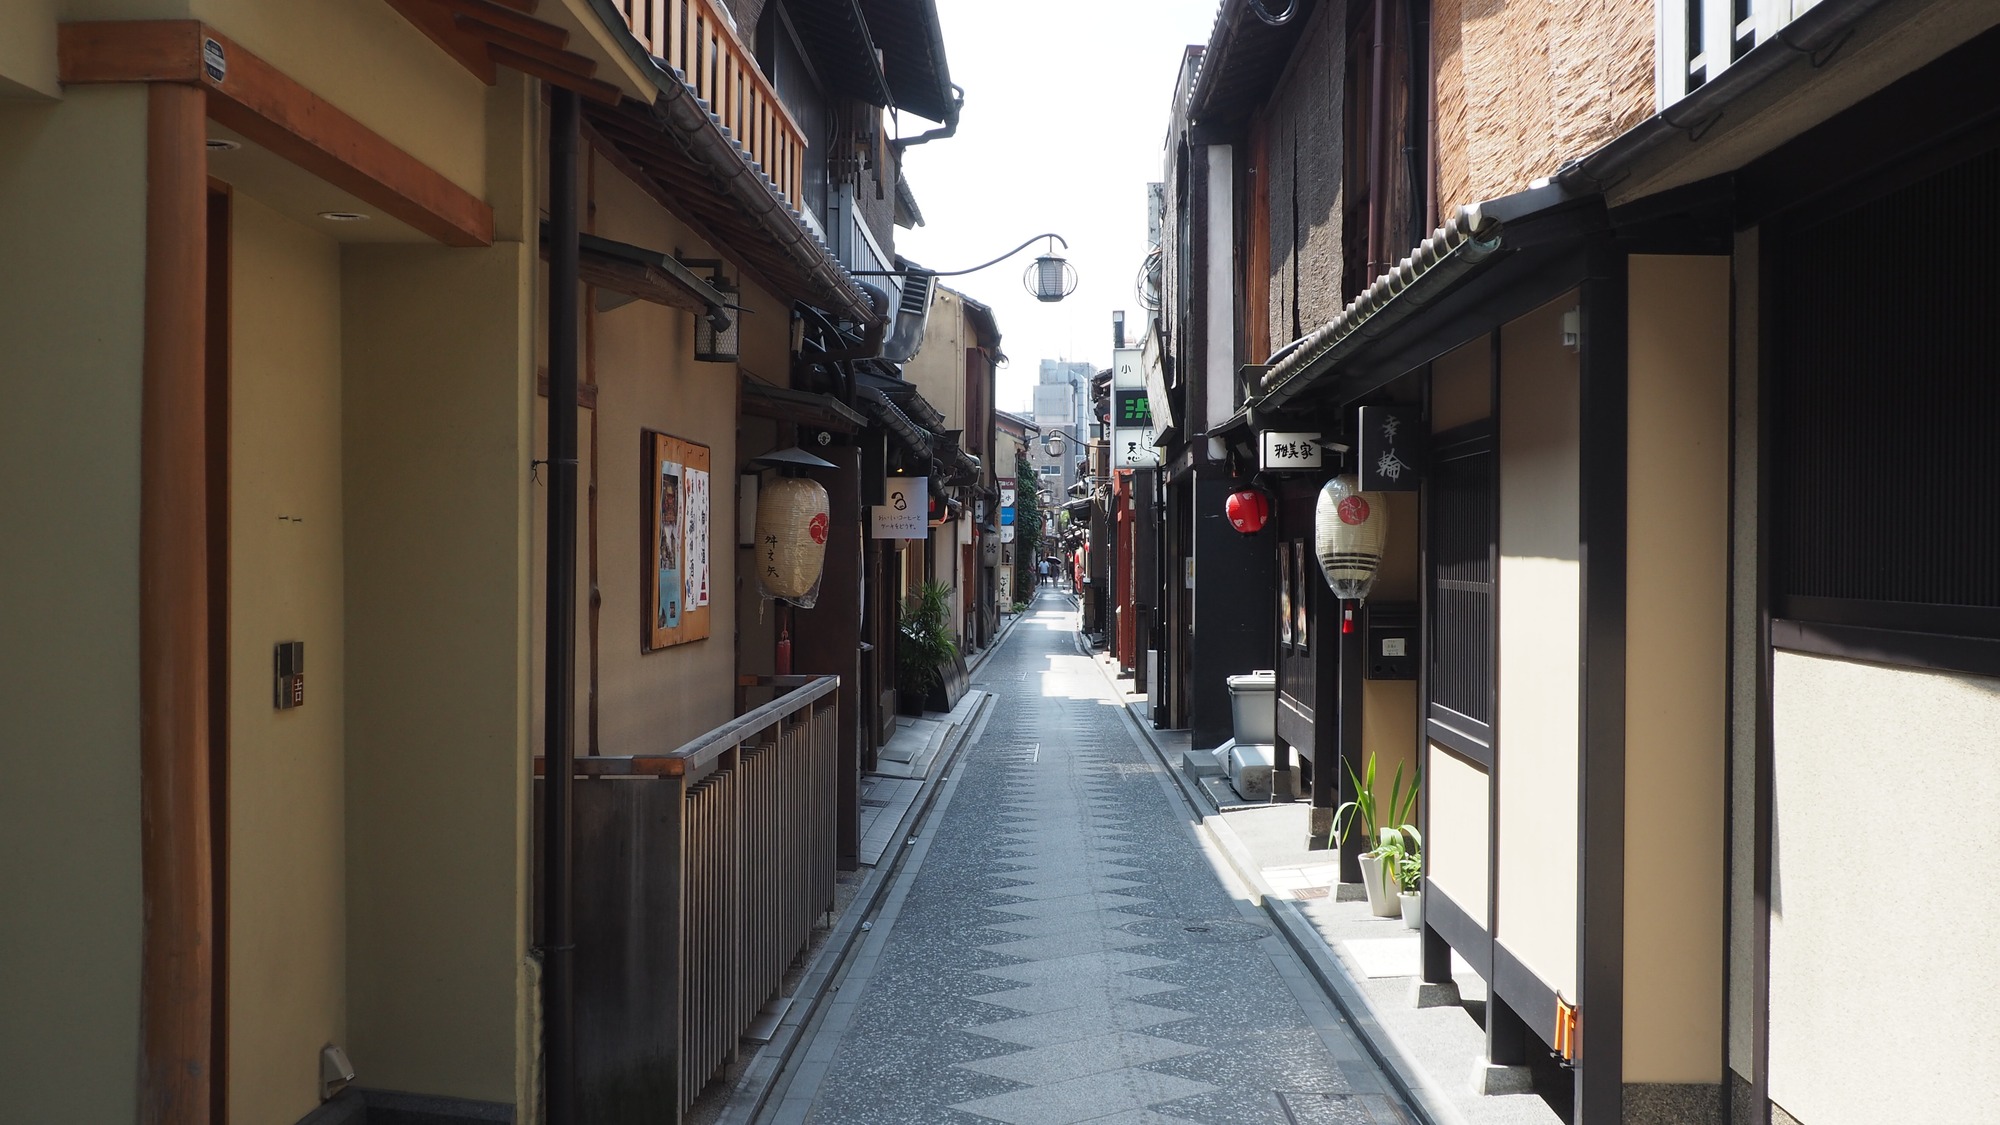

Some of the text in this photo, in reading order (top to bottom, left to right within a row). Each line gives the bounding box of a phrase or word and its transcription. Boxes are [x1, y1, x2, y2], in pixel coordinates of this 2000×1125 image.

[1121, 364, 1132, 375] 小
[1274, 441, 1314, 460] 雅美家
[1376, 414, 1411, 483] 幸輪
